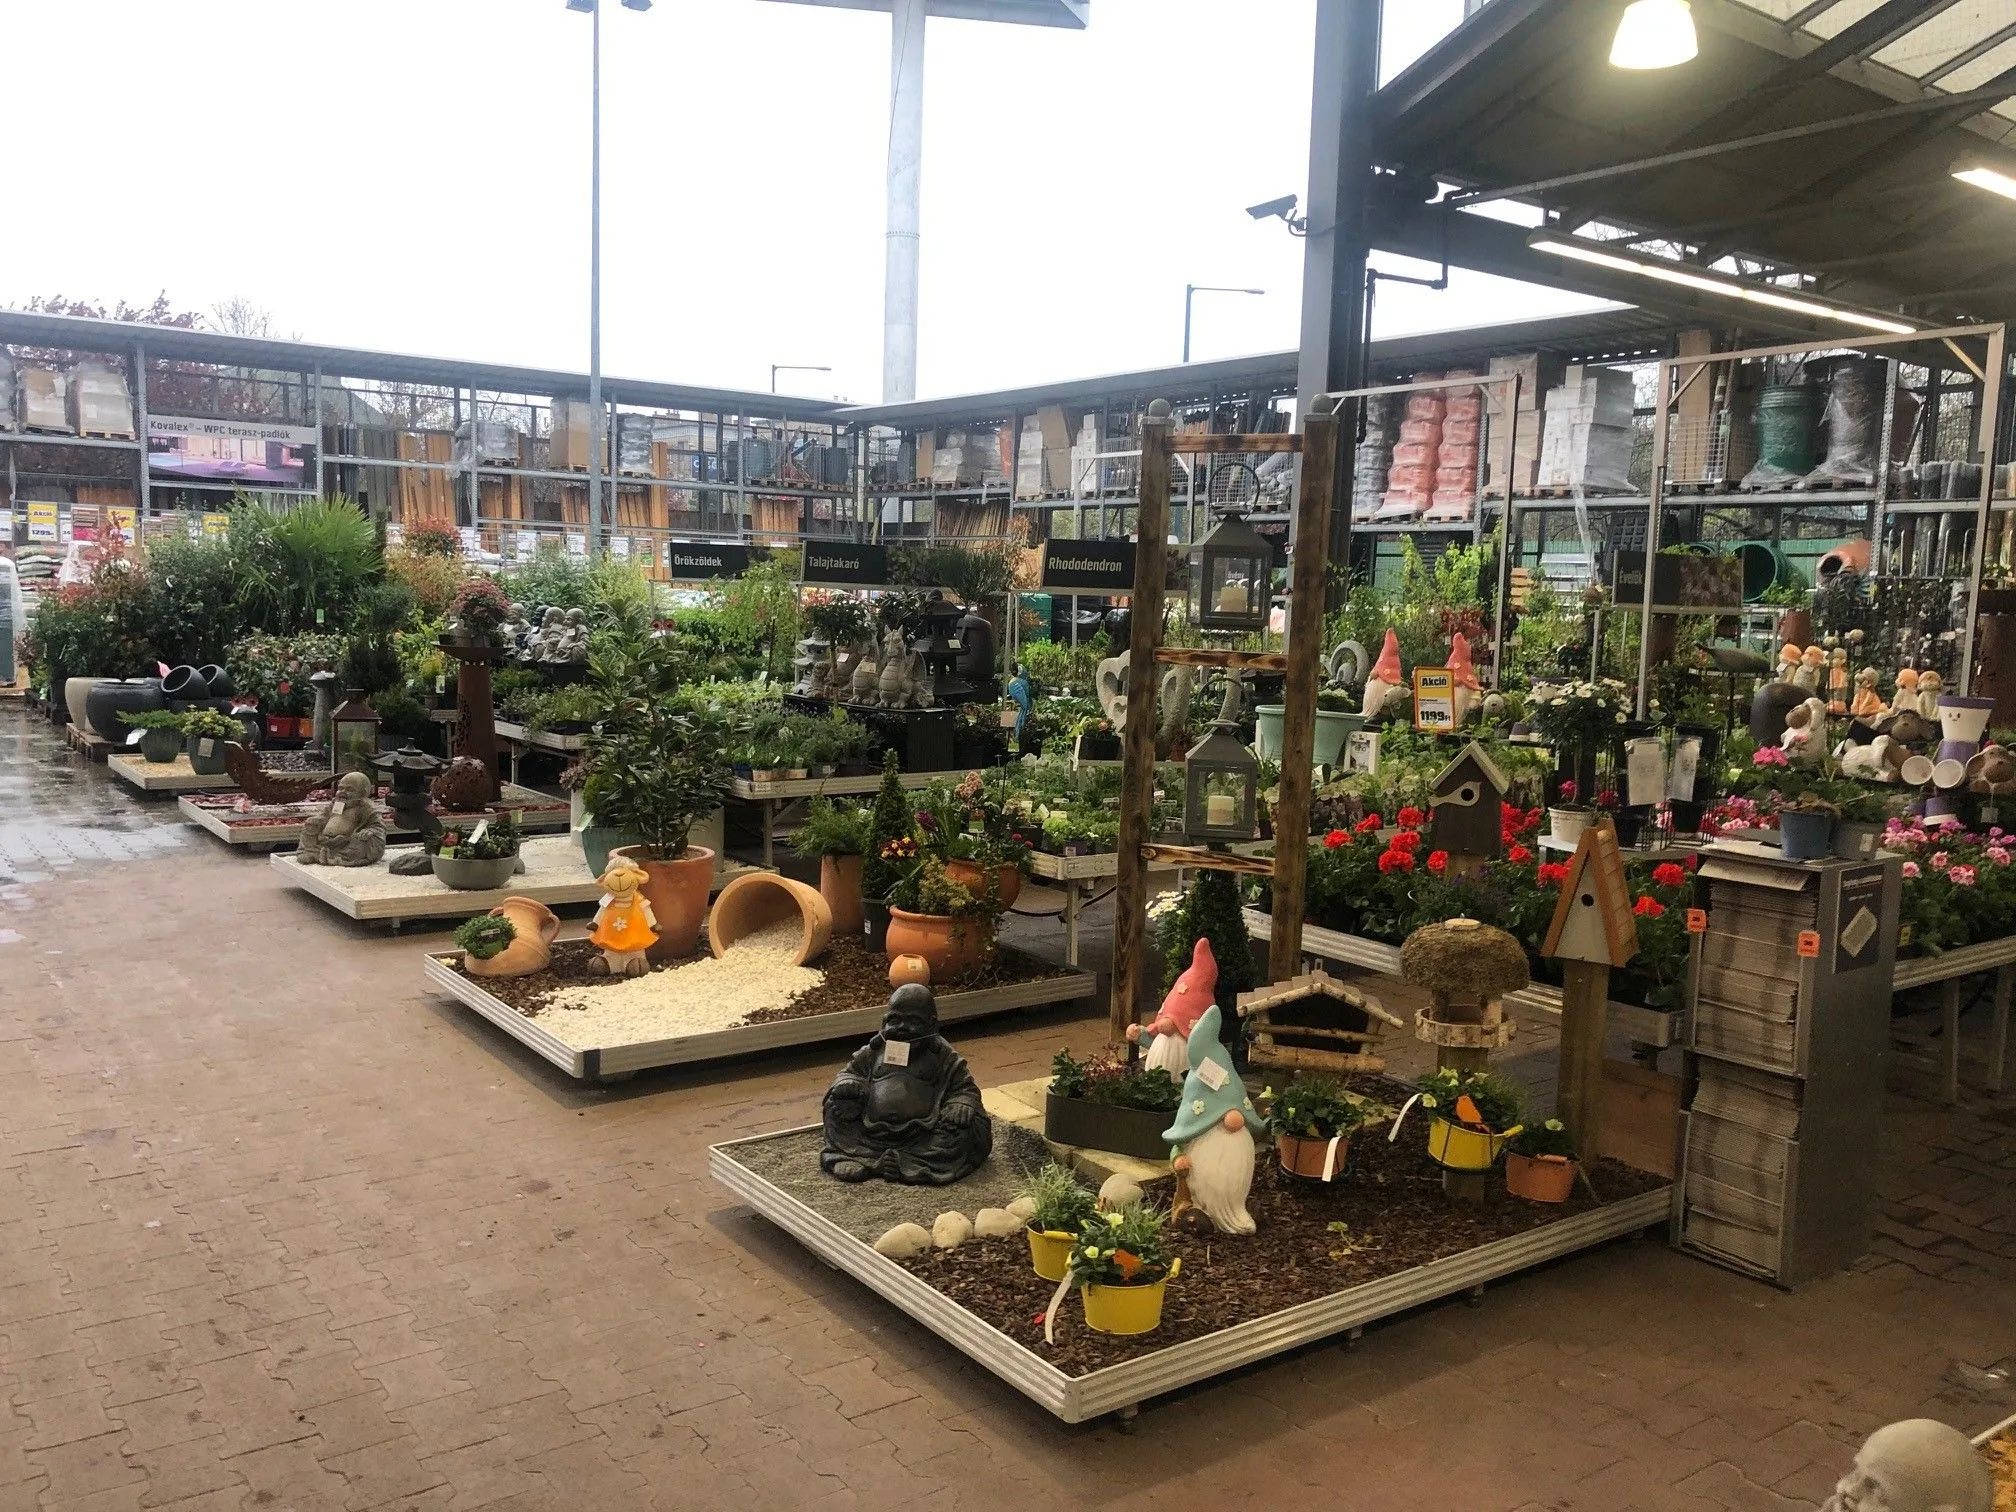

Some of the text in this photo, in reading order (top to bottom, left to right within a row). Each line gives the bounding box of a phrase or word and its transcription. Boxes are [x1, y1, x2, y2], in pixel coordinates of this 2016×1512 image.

[203, 424, 226, 435] WPC
[228, 426, 291, 440] terasz-padlók
[674, 553, 723, 568] Örökzöldek
[808, 555, 860, 570] Talajtakaró
[1048, 556, 1122, 572] Rhododendron
[1421, 676, 1447, 687] Akció
